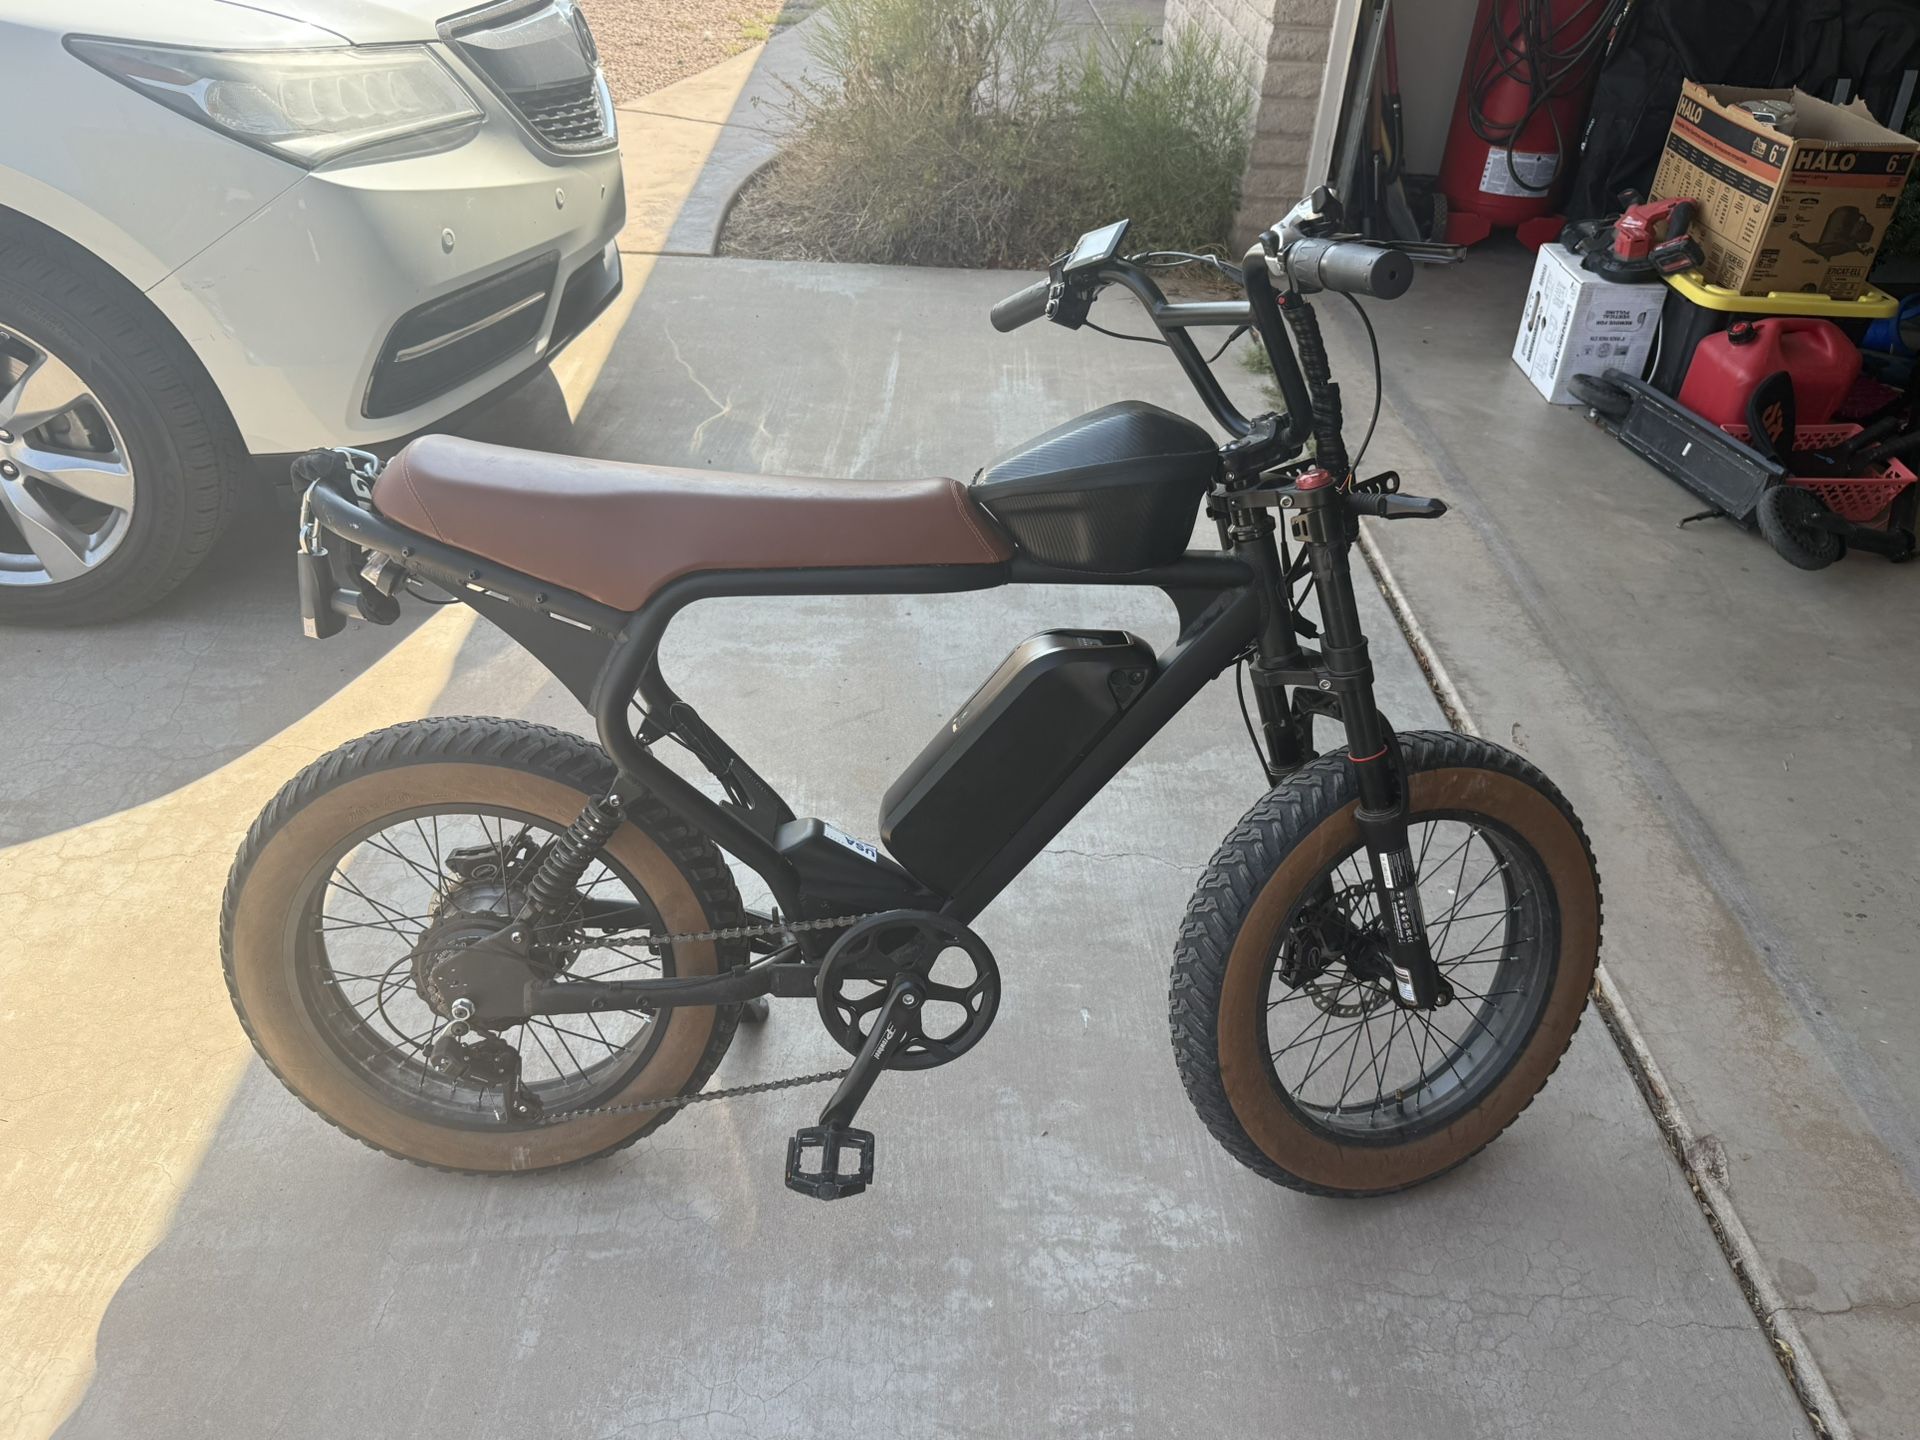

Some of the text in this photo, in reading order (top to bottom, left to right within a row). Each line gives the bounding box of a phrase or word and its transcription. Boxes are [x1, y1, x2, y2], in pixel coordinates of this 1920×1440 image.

[1679, 97, 1703, 125] HALO
[1794, 151, 1857, 172] HALO
[845, 836, 875, 858] USA
